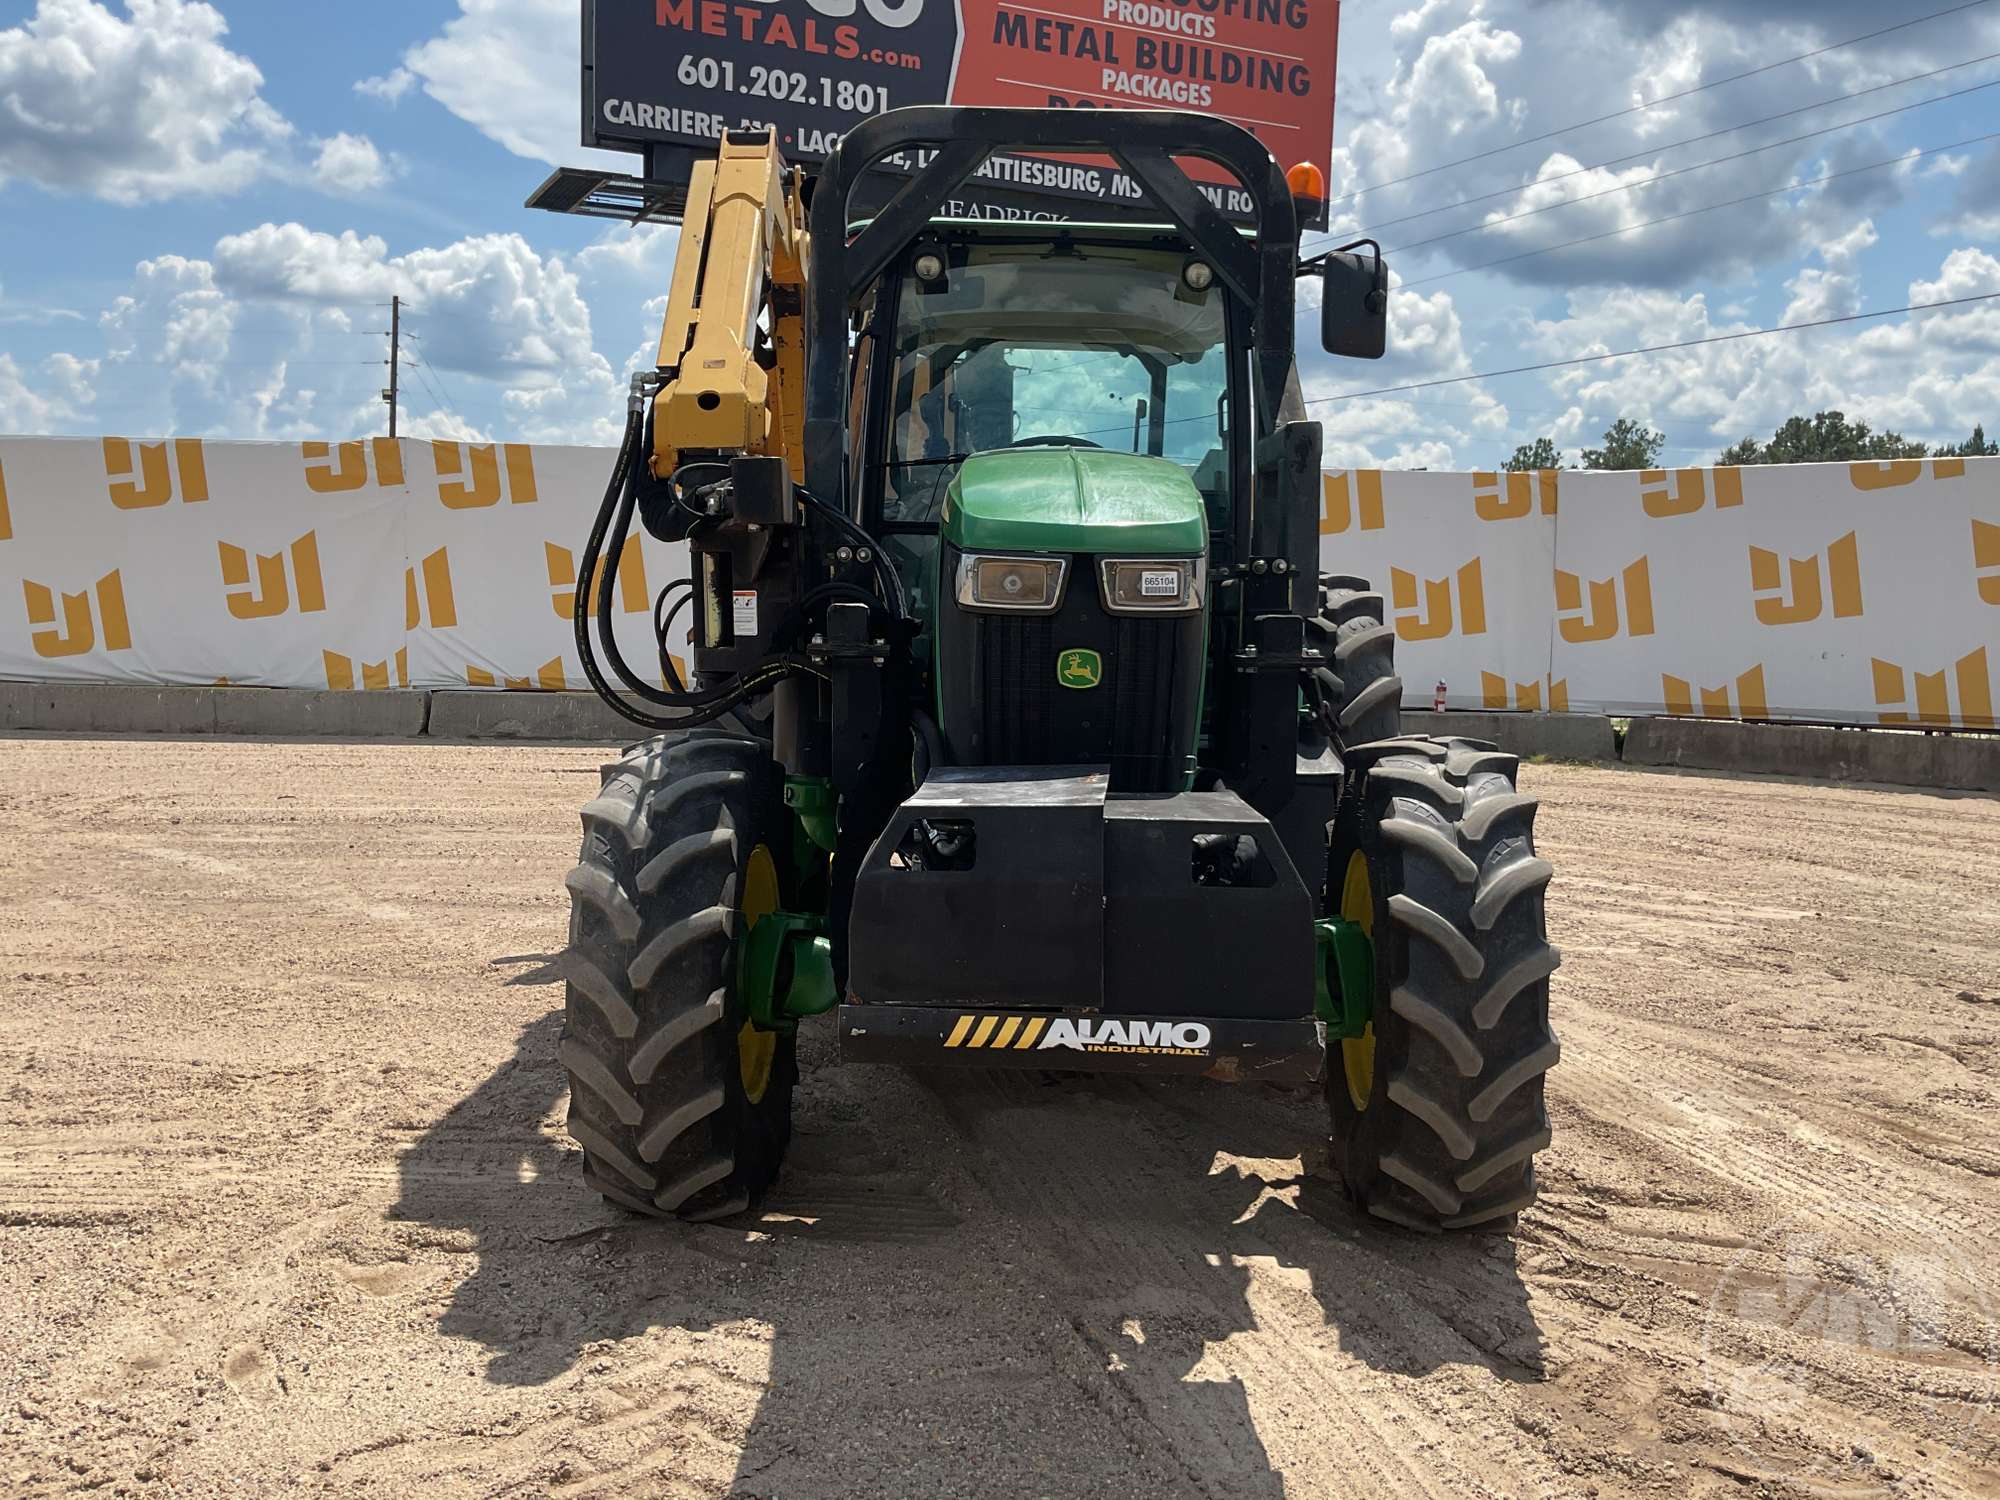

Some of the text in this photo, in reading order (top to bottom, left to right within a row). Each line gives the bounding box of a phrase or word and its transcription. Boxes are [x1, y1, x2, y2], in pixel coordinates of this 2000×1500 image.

[1103, 0, 1216, 38] PRODUCTS
[993, 11, 1311, 97] METAL BUILDING
[677, 54, 888, 115] 601.202.1801
[1102, 68, 1212, 107] PACKAGES
[973, 156, 1106, 198] ATTIESBURG,
[1144, 577, 1175, 586] 665104
[1037, 1018, 1211, 1050] ALAMO
[1088, 1045, 1206, 1057] INDUSTRIAL
